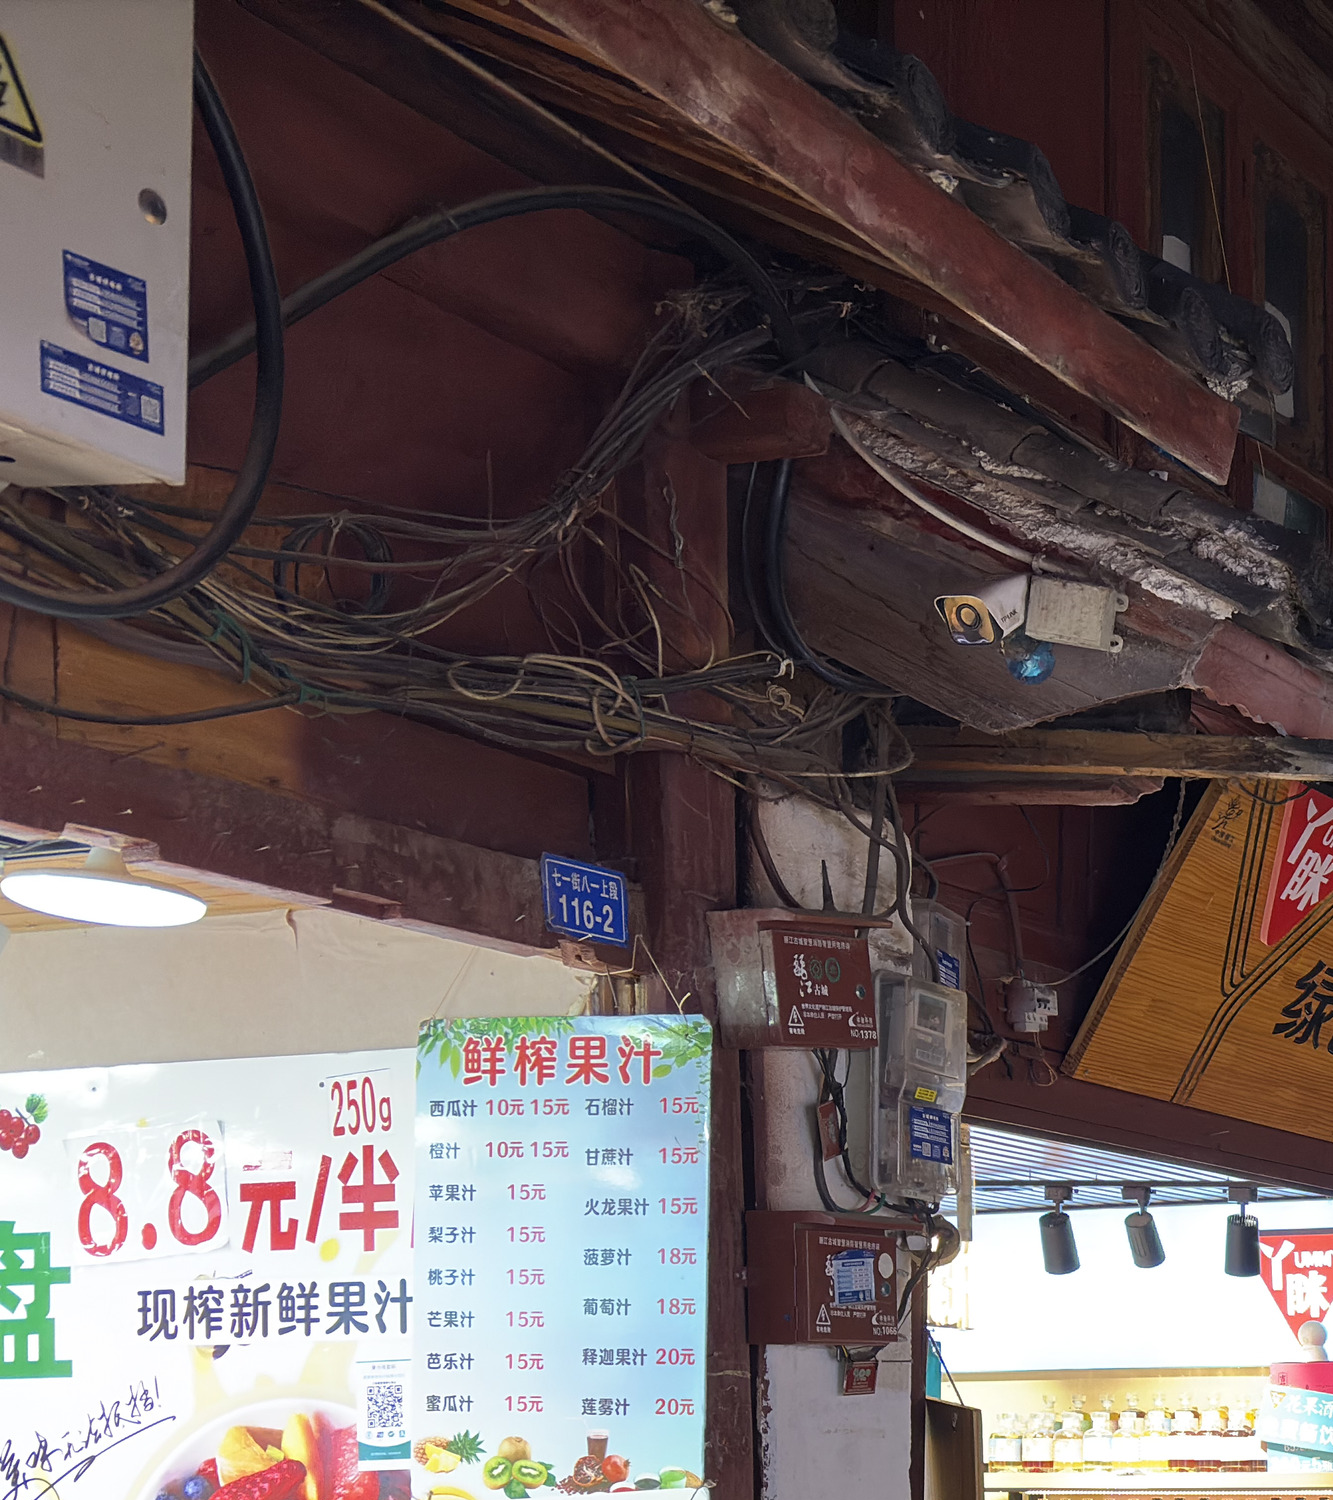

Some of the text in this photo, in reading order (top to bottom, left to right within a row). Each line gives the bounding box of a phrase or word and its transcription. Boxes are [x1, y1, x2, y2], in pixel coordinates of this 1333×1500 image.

[552, 867, 619, 901] 七一街八一上段
[558, 894, 614, 933] 116-2
[462, 1034, 662, 1086] 鲜榨果汁
[331, 1076, 392, 1136] 250g
[429, 1099, 570, 1117] 西瓜汁 10元 15元
[585, 1097, 699, 1116] 石榴汁 15元
[429, 1141, 569, 1159] 橙汁 10元 15元
[585, 1147, 698, 1166] 甘蔗汁 15元
[78, 1129, 414, 1258] 8.8元/半
[429, 1184, 546, 1201] 苹果汁 15元
[584, 1198, 698, 1216] 火龙果汁 15元
[428, 1226, 546, 1244] 梨子汁 15元
[583, 1247, 697, 1266] 菠萝汁 18元
[427, 1268, 545, 1286] 桃子汁 15元
[137, 1279, 413, 1341] 现榨新鲜果汁
[583, 1298, 696, 1316] 葡萄汁 18元
[427, 1310, 545, 1328] 芒果汁 15元
[426, 1352, 544, 1370] 芭乐汁 15元
[582, 1348, 695, 1366] 释迦果汁 20元
[426, 1394, 544, 1413] 蜜瓜汁 15元
[581, 1397, 695, 1416] 莲雾汁 20元
